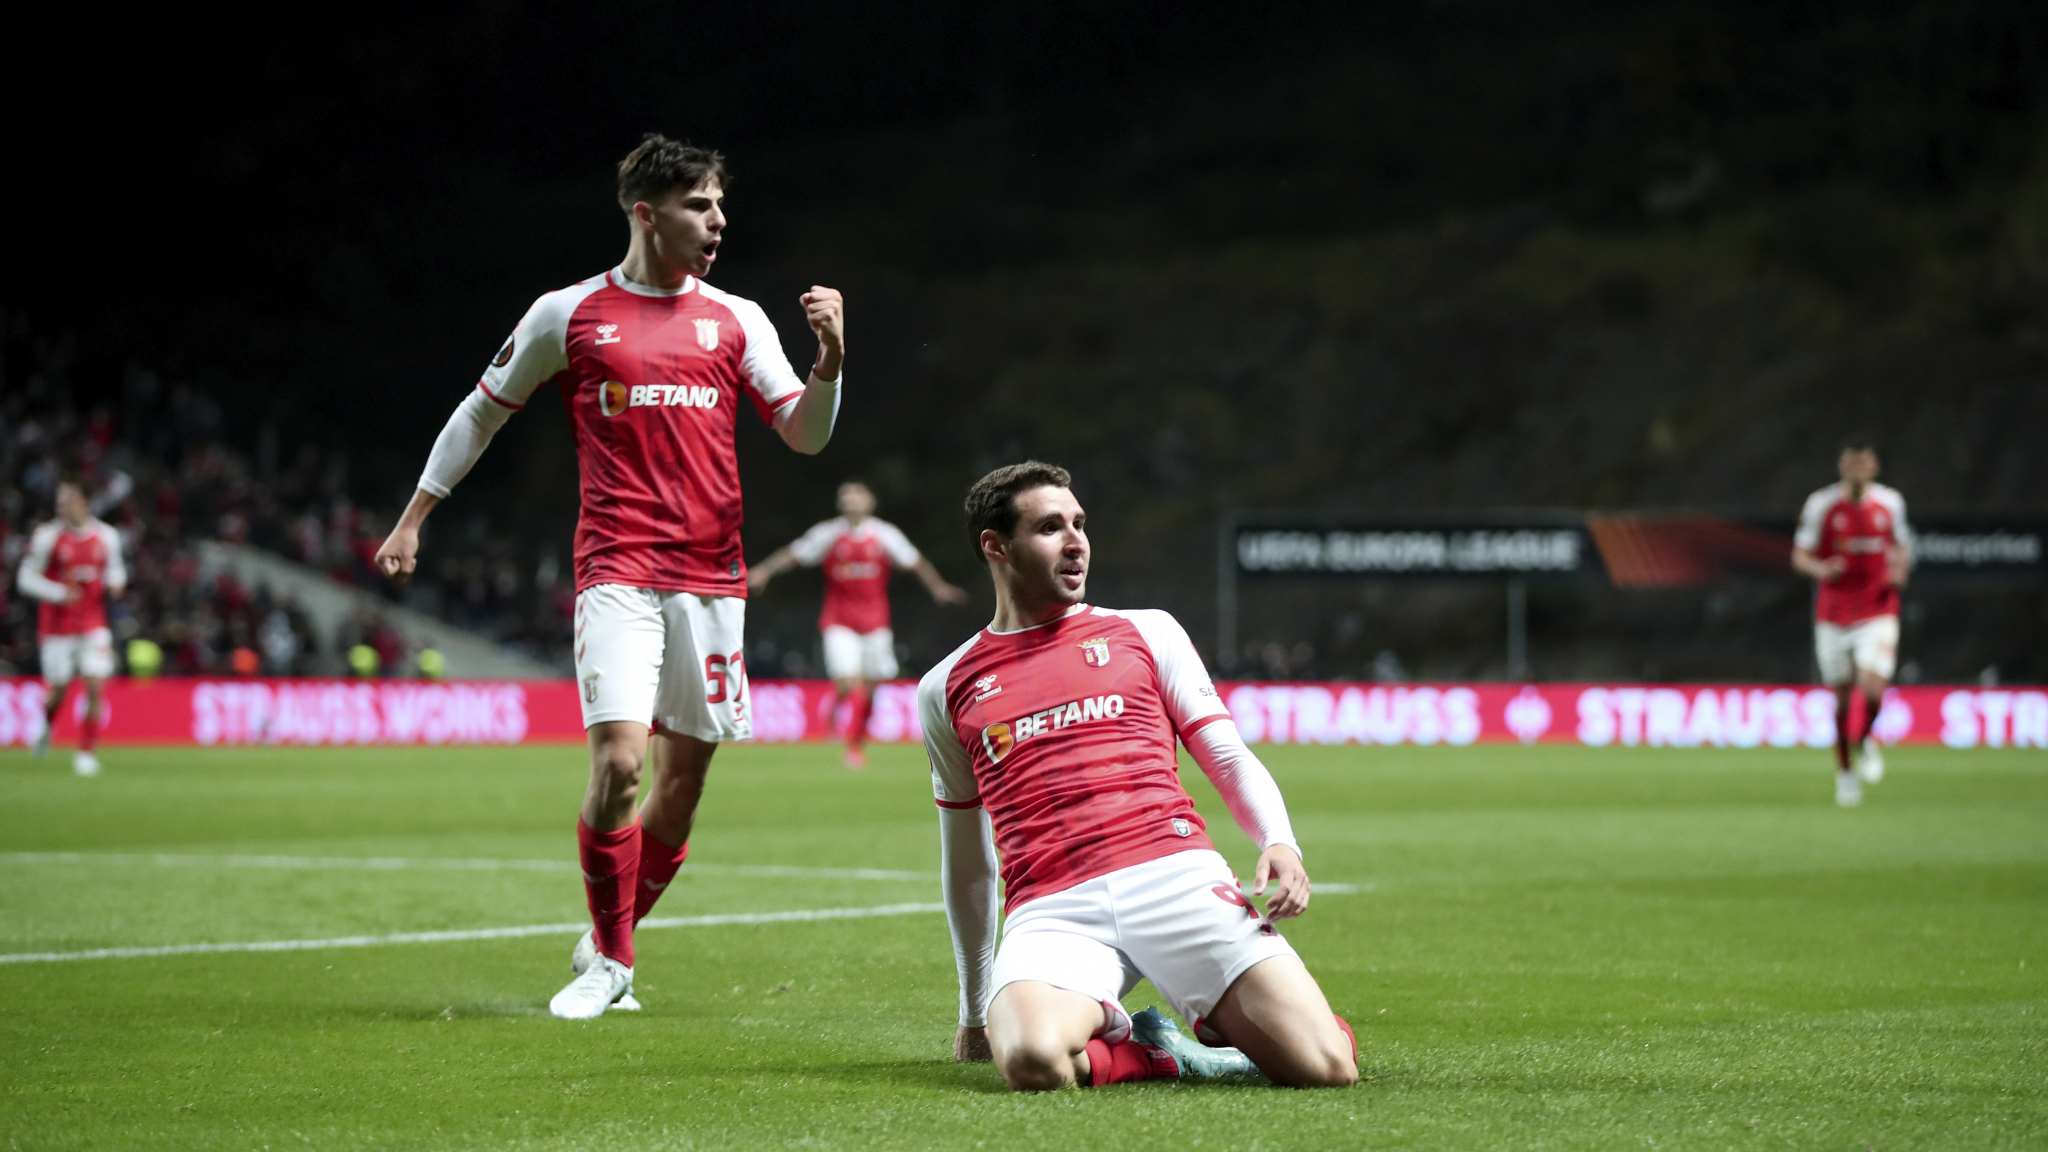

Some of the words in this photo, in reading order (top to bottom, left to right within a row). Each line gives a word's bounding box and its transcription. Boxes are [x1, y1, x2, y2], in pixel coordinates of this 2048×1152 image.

[629, 384, 719, 409] BETANO
[1237, 531, 1321, 571] UEFA
[1325, 532, 1447, 571] EUROPA
[1450, 531, 1580, 571] LEAGUE
[975, 685, 1002, 703] hummel
[1228, 685, 1481, 746] STRAUSS
[1015, 694, 1124, 743] BETANO
[1577, 687, 1837, 748] STRAUSS
